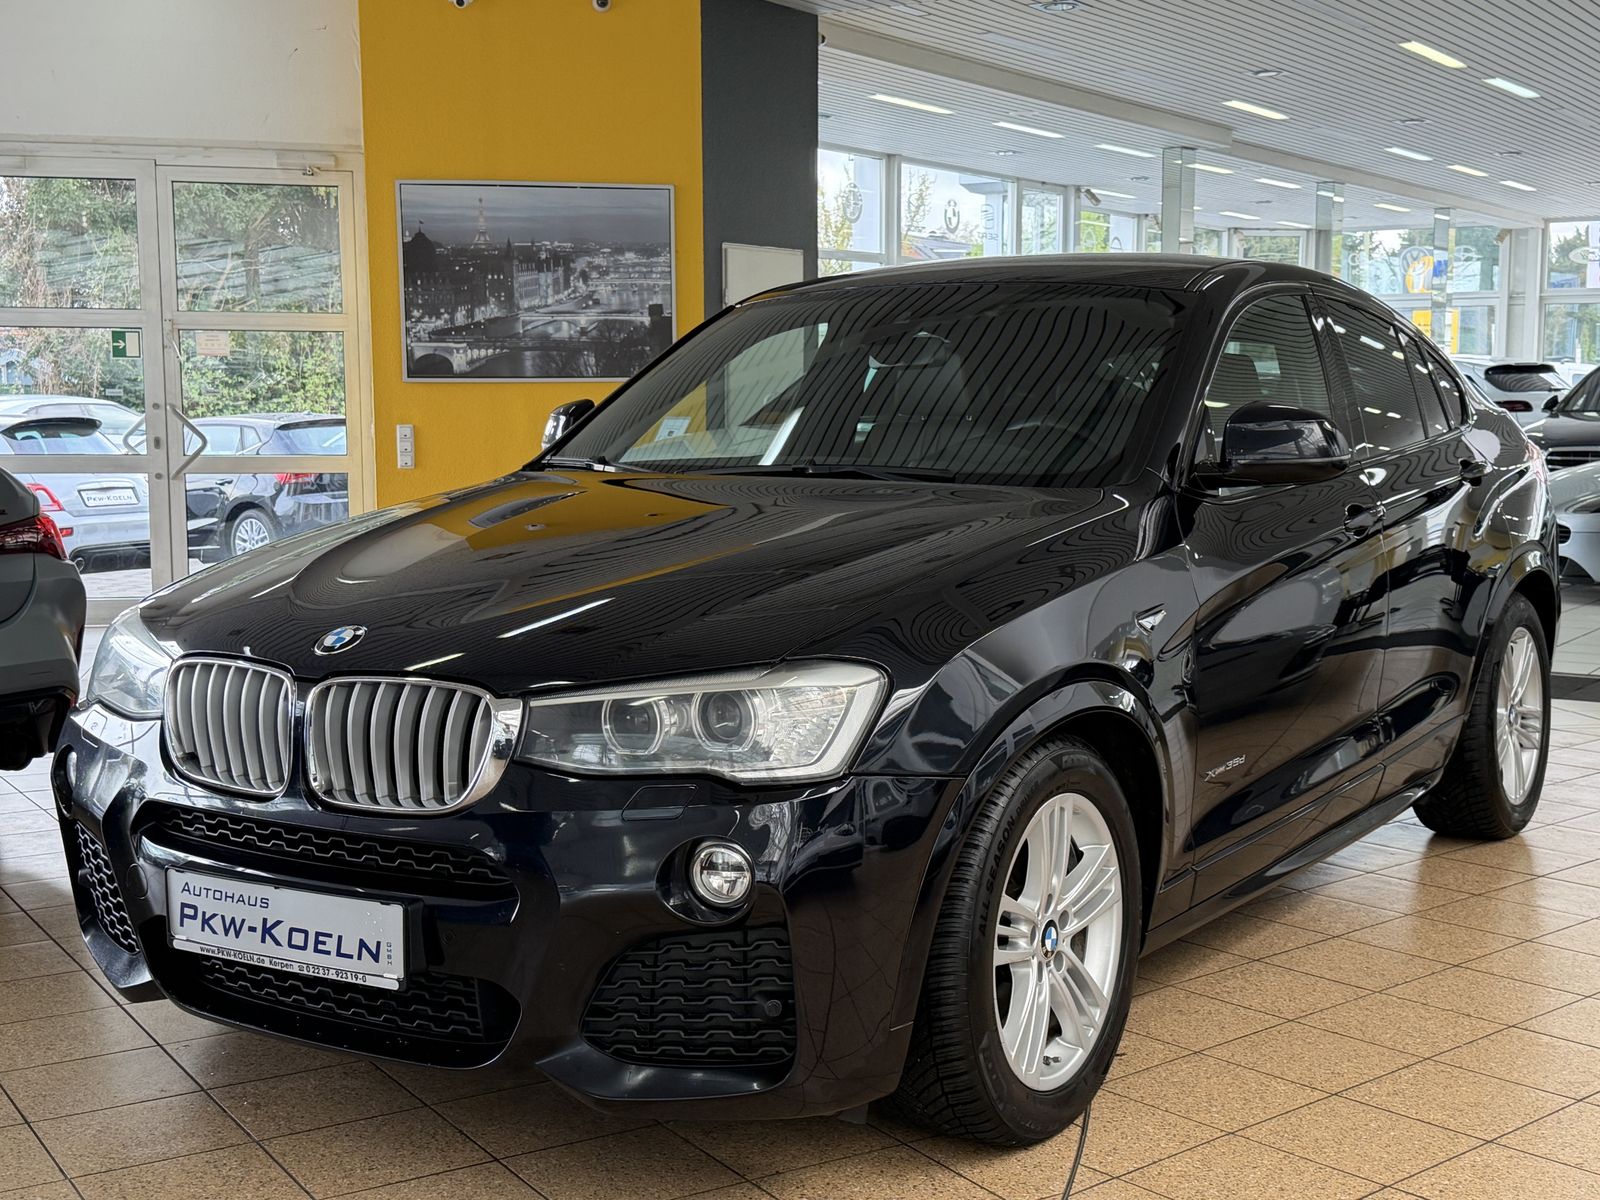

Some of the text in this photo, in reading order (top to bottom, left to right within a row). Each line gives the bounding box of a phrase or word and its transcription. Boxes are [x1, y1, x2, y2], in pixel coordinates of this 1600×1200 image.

[181, 881, 270, 909] AUTOHAUS
[979, 900, 991, 936] ALL
[986, 815, 1016, 895] SEASON
[179, 901, 382, 964] PKW-KOELN
[199, 945, 266, 965] www.PKW-KOELN.de
[268, 957, 294, 971] Kerpen
